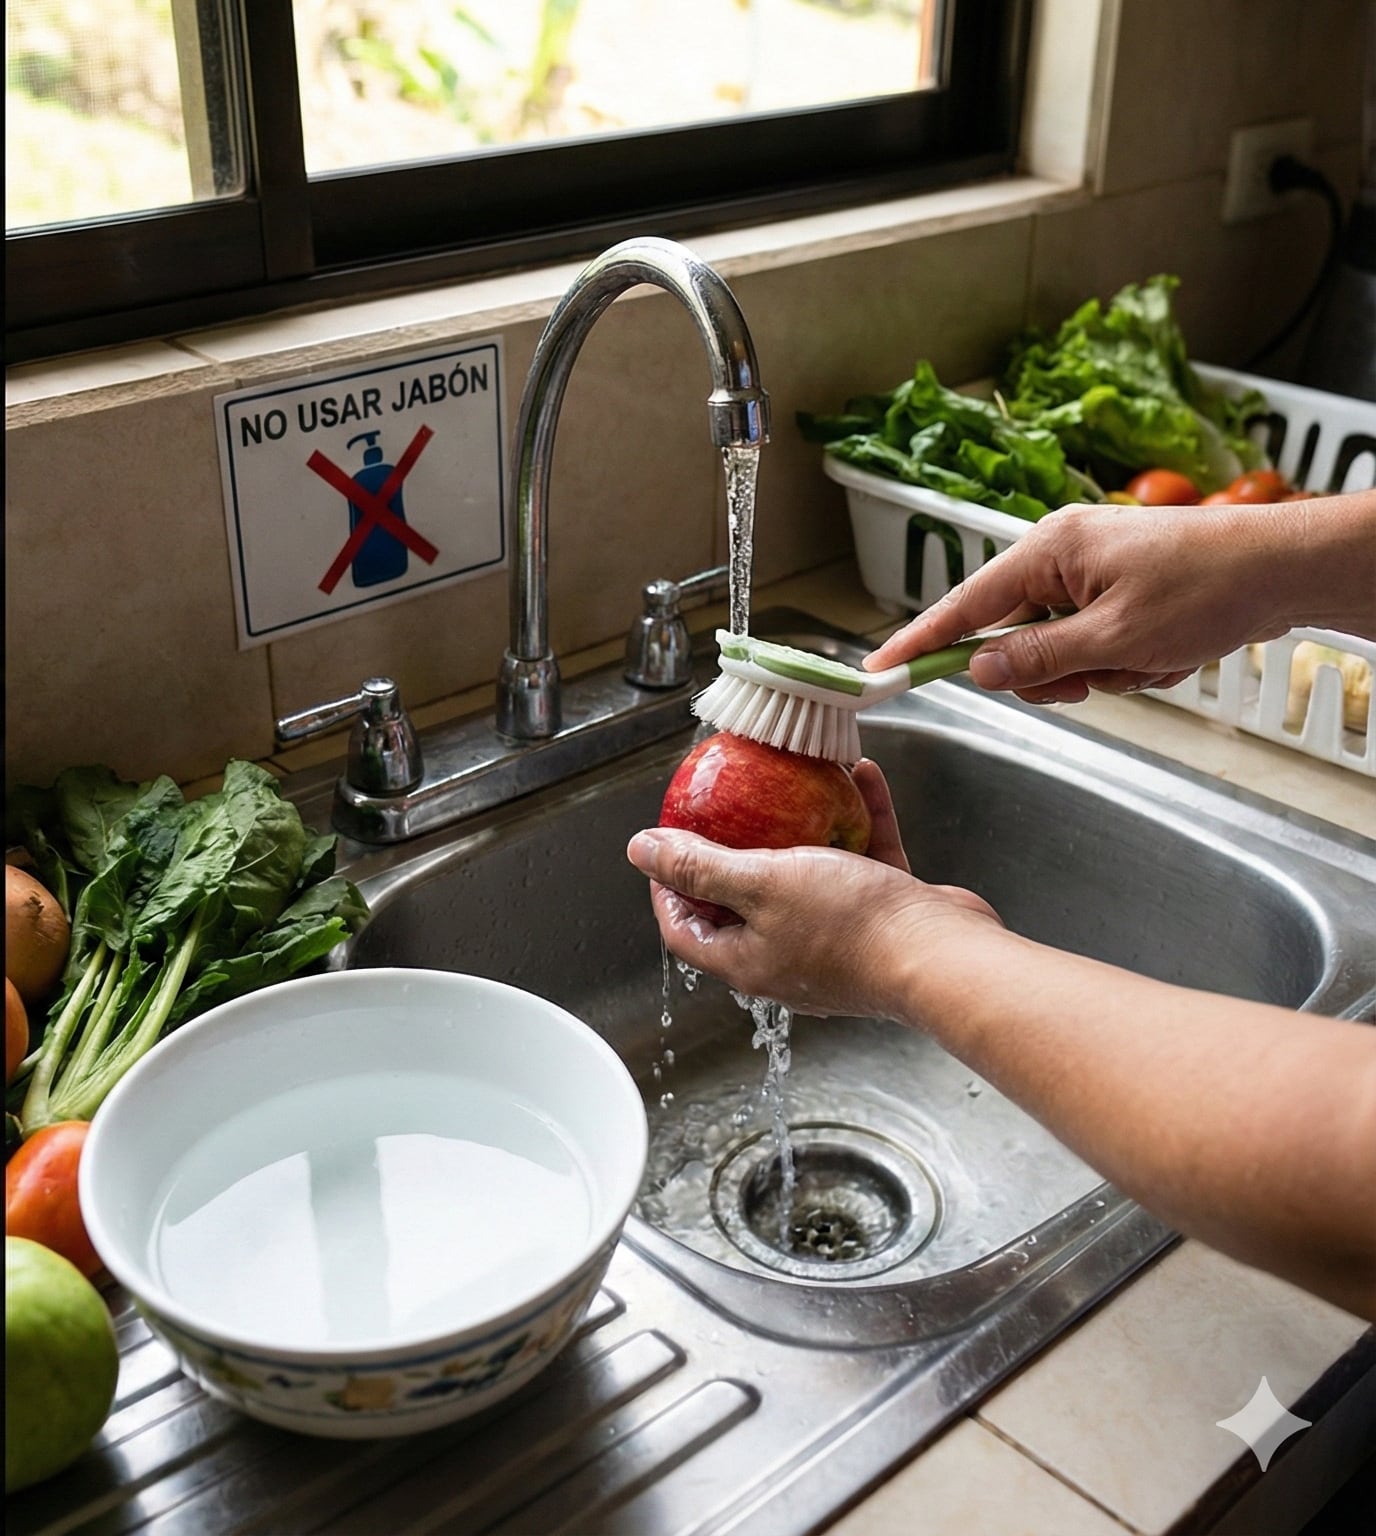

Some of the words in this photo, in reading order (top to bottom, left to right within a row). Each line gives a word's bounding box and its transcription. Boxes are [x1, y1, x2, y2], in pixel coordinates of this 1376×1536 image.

[240, 409, 288, 447] NO
[297, 387, 383, 433] USAR
[391, 361, 489, 412] JABÓN
